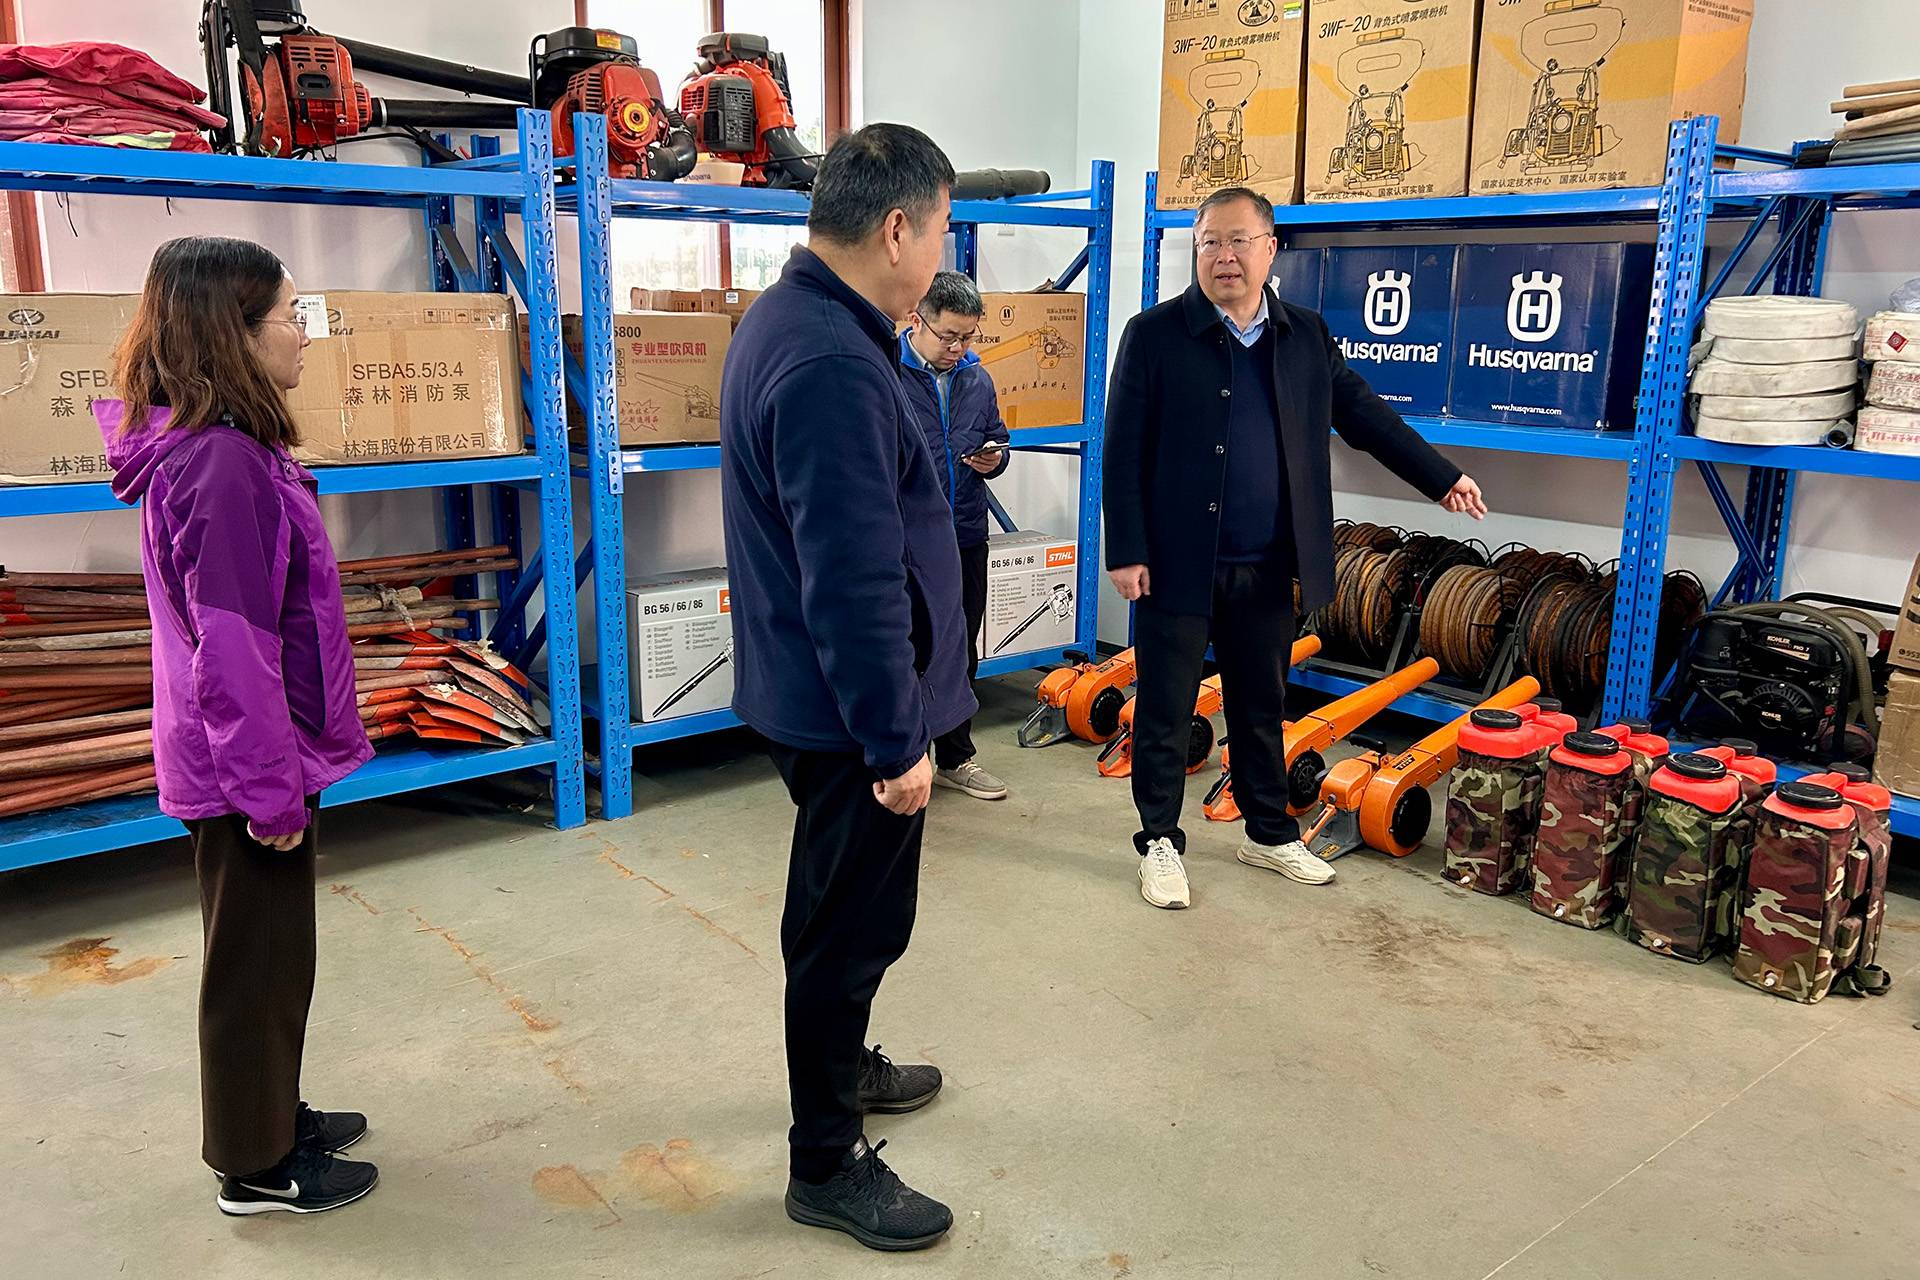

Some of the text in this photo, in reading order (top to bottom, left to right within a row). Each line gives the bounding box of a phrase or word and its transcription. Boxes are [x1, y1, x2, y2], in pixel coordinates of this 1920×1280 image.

[1318, 5, 1448, 39] 3WF-20 背负式喷雾喷粉机
[1172, 31, 1280, 54] 3WF-20 背负式喷雾喷粉机
[1481, 171, 1628, 189] 国家认定技术中心 国家认可实验室
[1378, 184, 1434, 197] 国家认可实验室
[631, 342, 707, 356] 专业型吹风机
[1333, 336, 1438, 364] Husqvarna
[1468, 343, 1594, 373] Husqvarna
[352, 361, 464, 380] SFBA5.5/3.4
[344, 383, 471, 406] 森林消防泵
[1491, 403, 1562, 416] www.husqvarna.com
[343, 431, 486, 458] 林海股份有限公司
[991, 559, 1001, 569] BG
[1002, 558, 1010, 567] 56
[1048, 551, 1073, 563] STIHL
[644, 604, 658, 615] BG
[659, 603, 670, 613] 56
[676, 601, 687, 611] 66
[693, 599, 703, 609] 86
[1766, 635, 1790, 644] KOHLER
